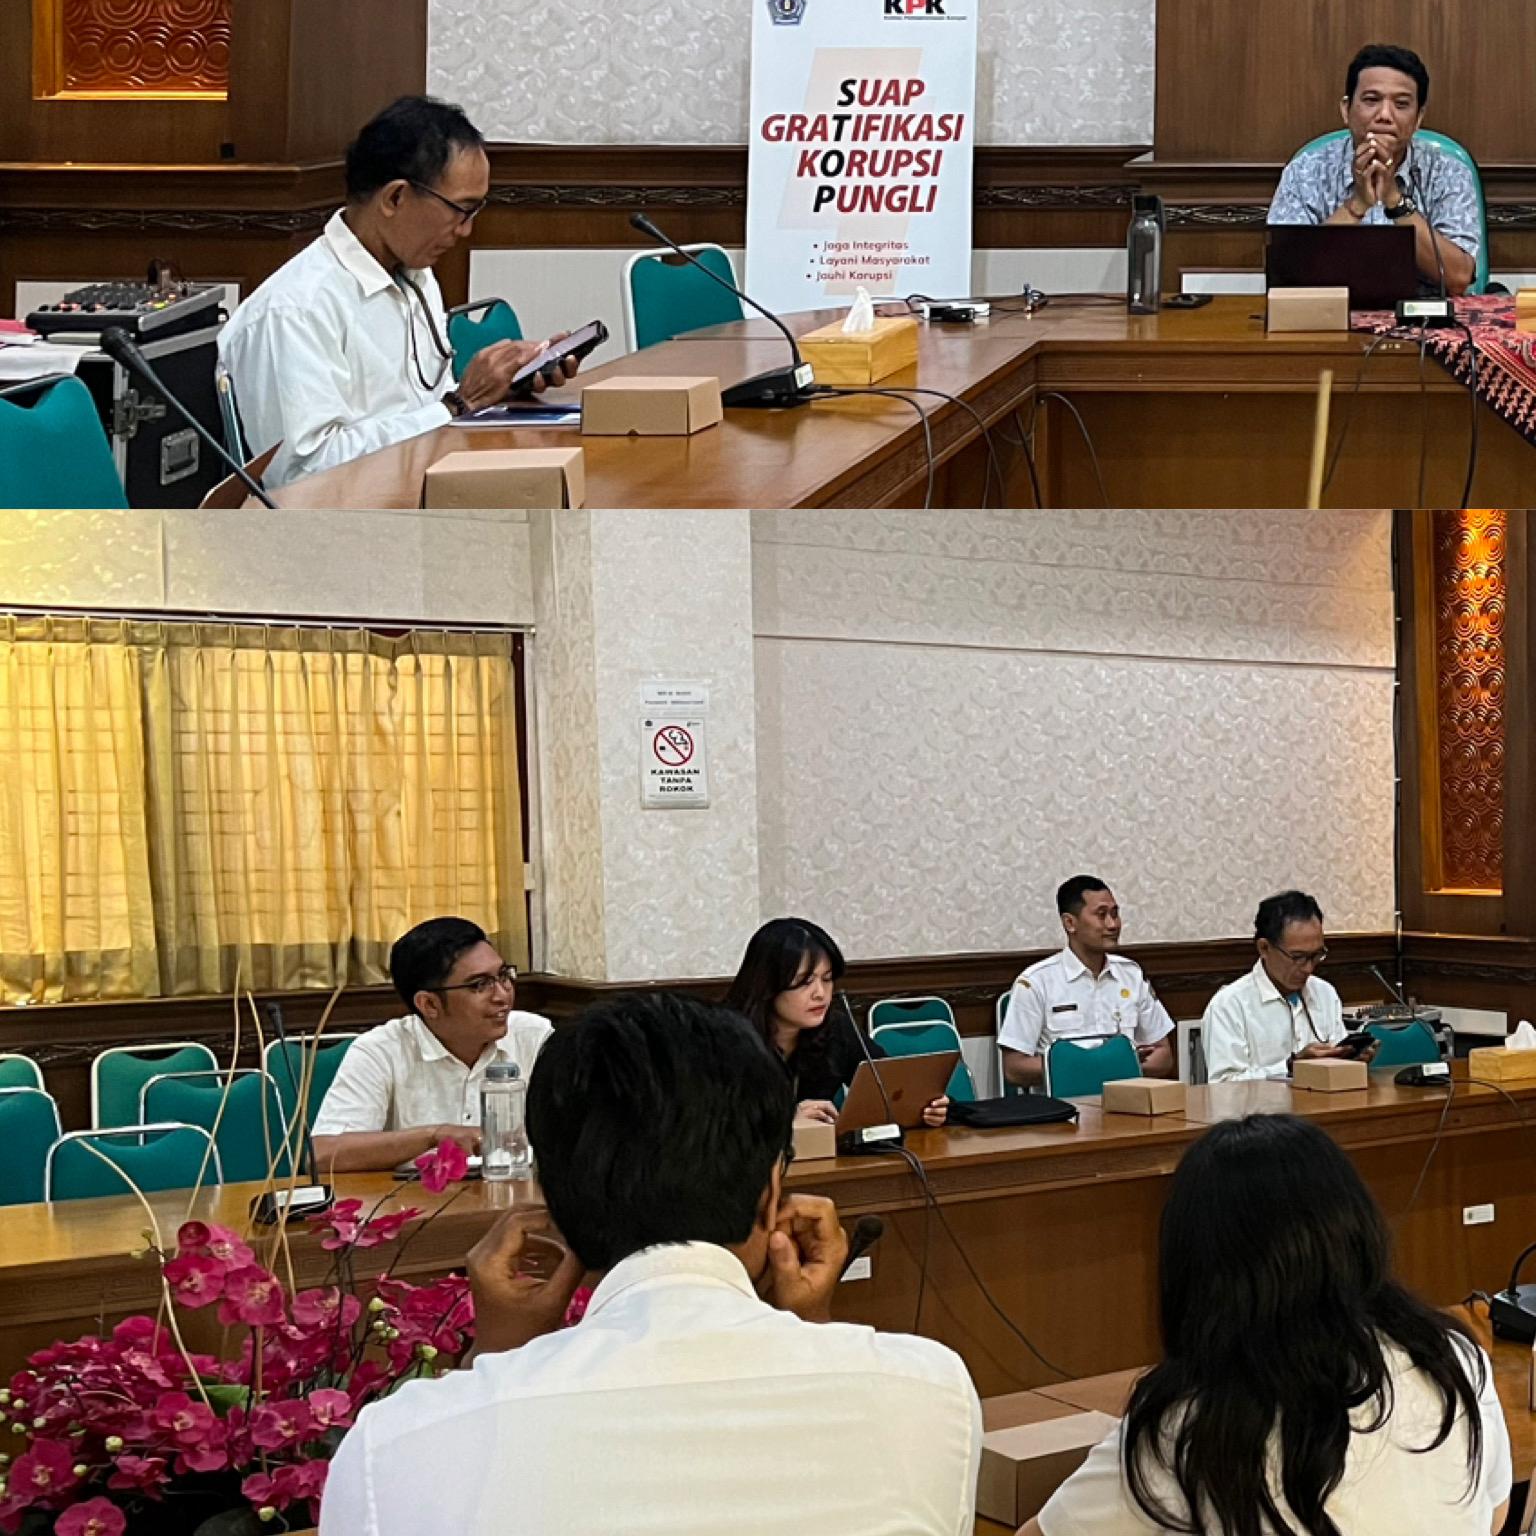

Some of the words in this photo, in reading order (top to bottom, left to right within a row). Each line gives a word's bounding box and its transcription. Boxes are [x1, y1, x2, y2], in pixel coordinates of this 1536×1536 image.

[837, 78, 926, 107] SUAP
[761, 114, 965, 143] GRATIFIKASI
[796, 149, 943, 178] KORUPSI
[812, 184, 938, 213] PUNGLI
[819, 255, 858, 267] Layani
[862, 255, 930, 267] Masyarakat
[823, 241, 850, 253] Jaga
[853, 240, 909, 253] Integritas
[816, 270, 845, 282] Jauhi
[849, 270, 893, 282] Korupsi
